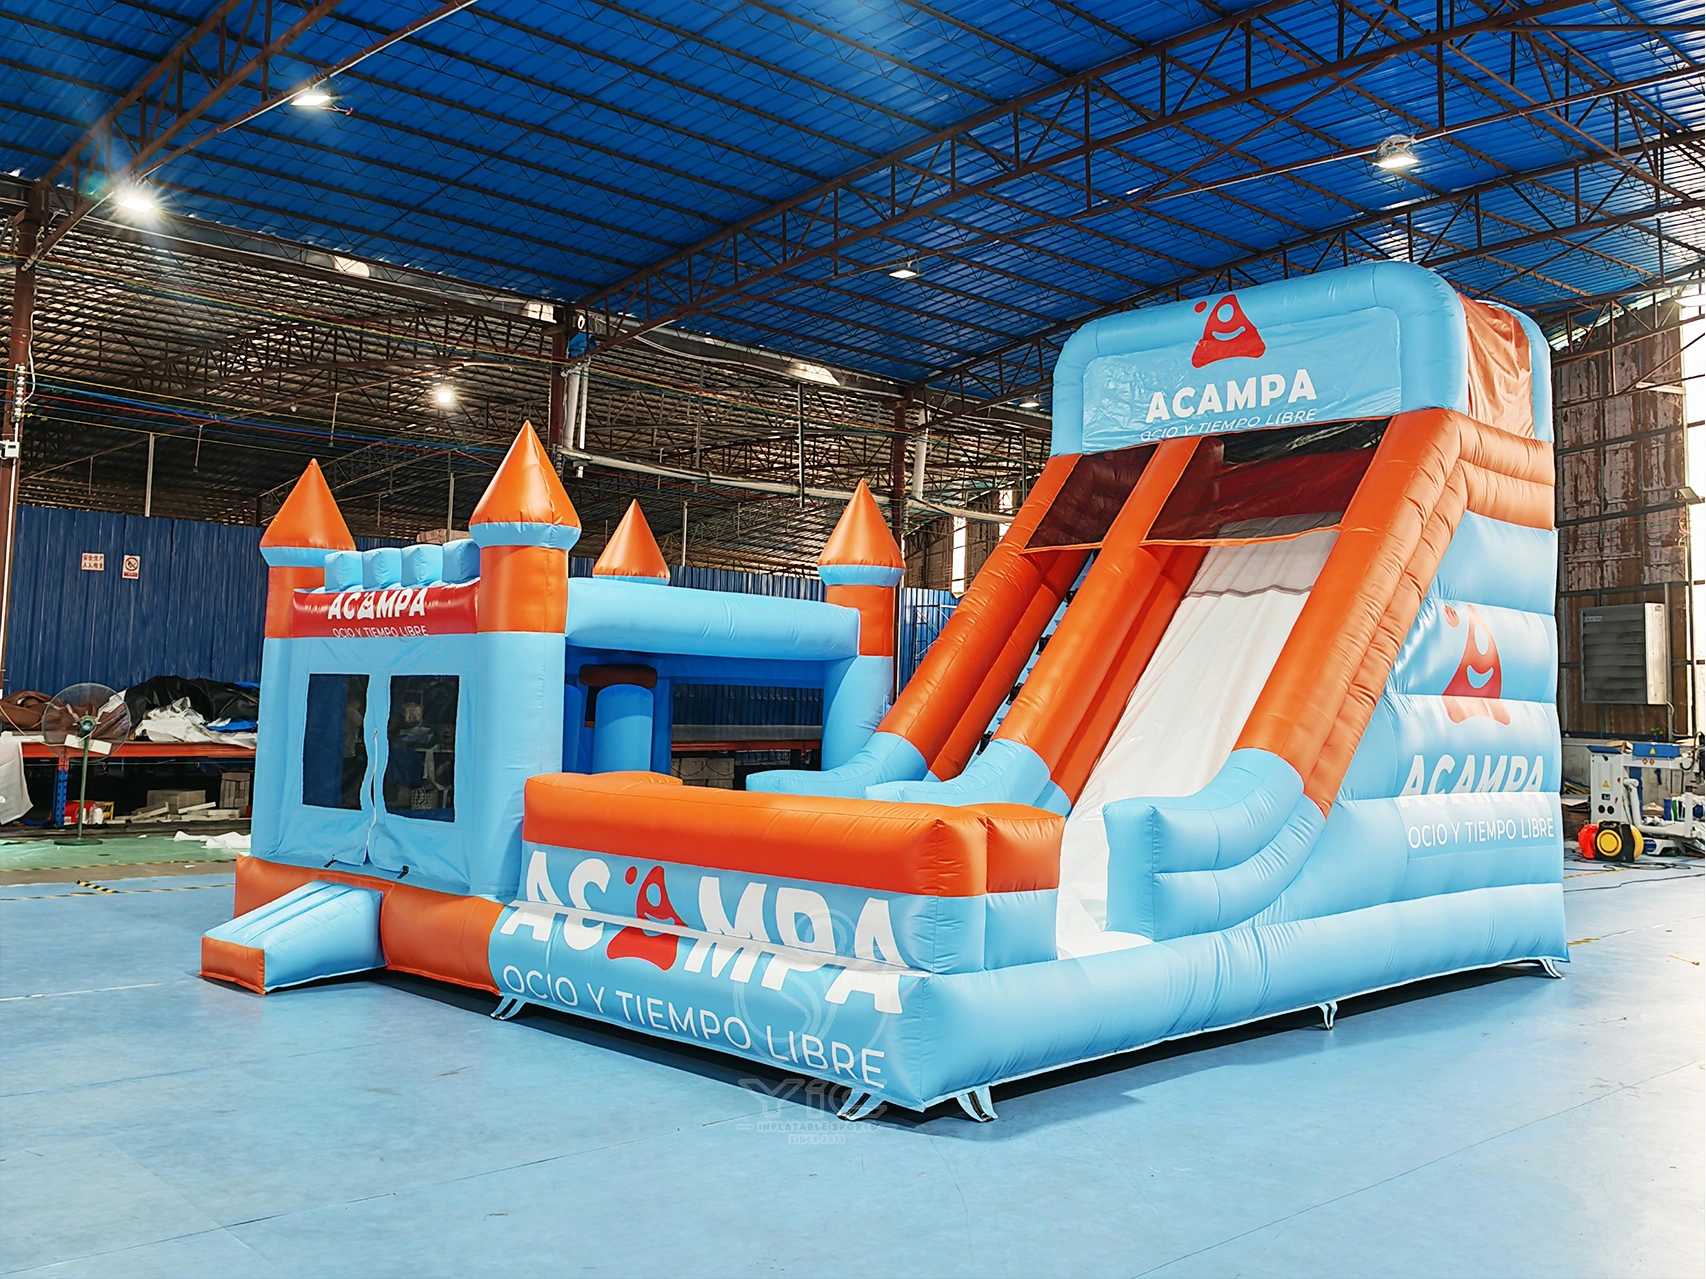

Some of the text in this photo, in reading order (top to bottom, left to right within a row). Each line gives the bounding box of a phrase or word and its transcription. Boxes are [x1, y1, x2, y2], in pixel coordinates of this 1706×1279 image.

[1145, 368, 1318, 423] ACAMPA
[1140, 408, 1318, 442] OCIO Y TIEMPO LIBRE
[332, 627, 356, 638] OCIO
[363, 627, 398, 638] TIEMPO
[399, 625, 429, 637] LIBRE
[1399, 754, 1544, 807] ACAMPA
[1407, 818, 1555, 850] OCIO Y TIEMPO LIBRE
[502, 965, 886, 1090] OCIO Y TIEMPO LIBRE
